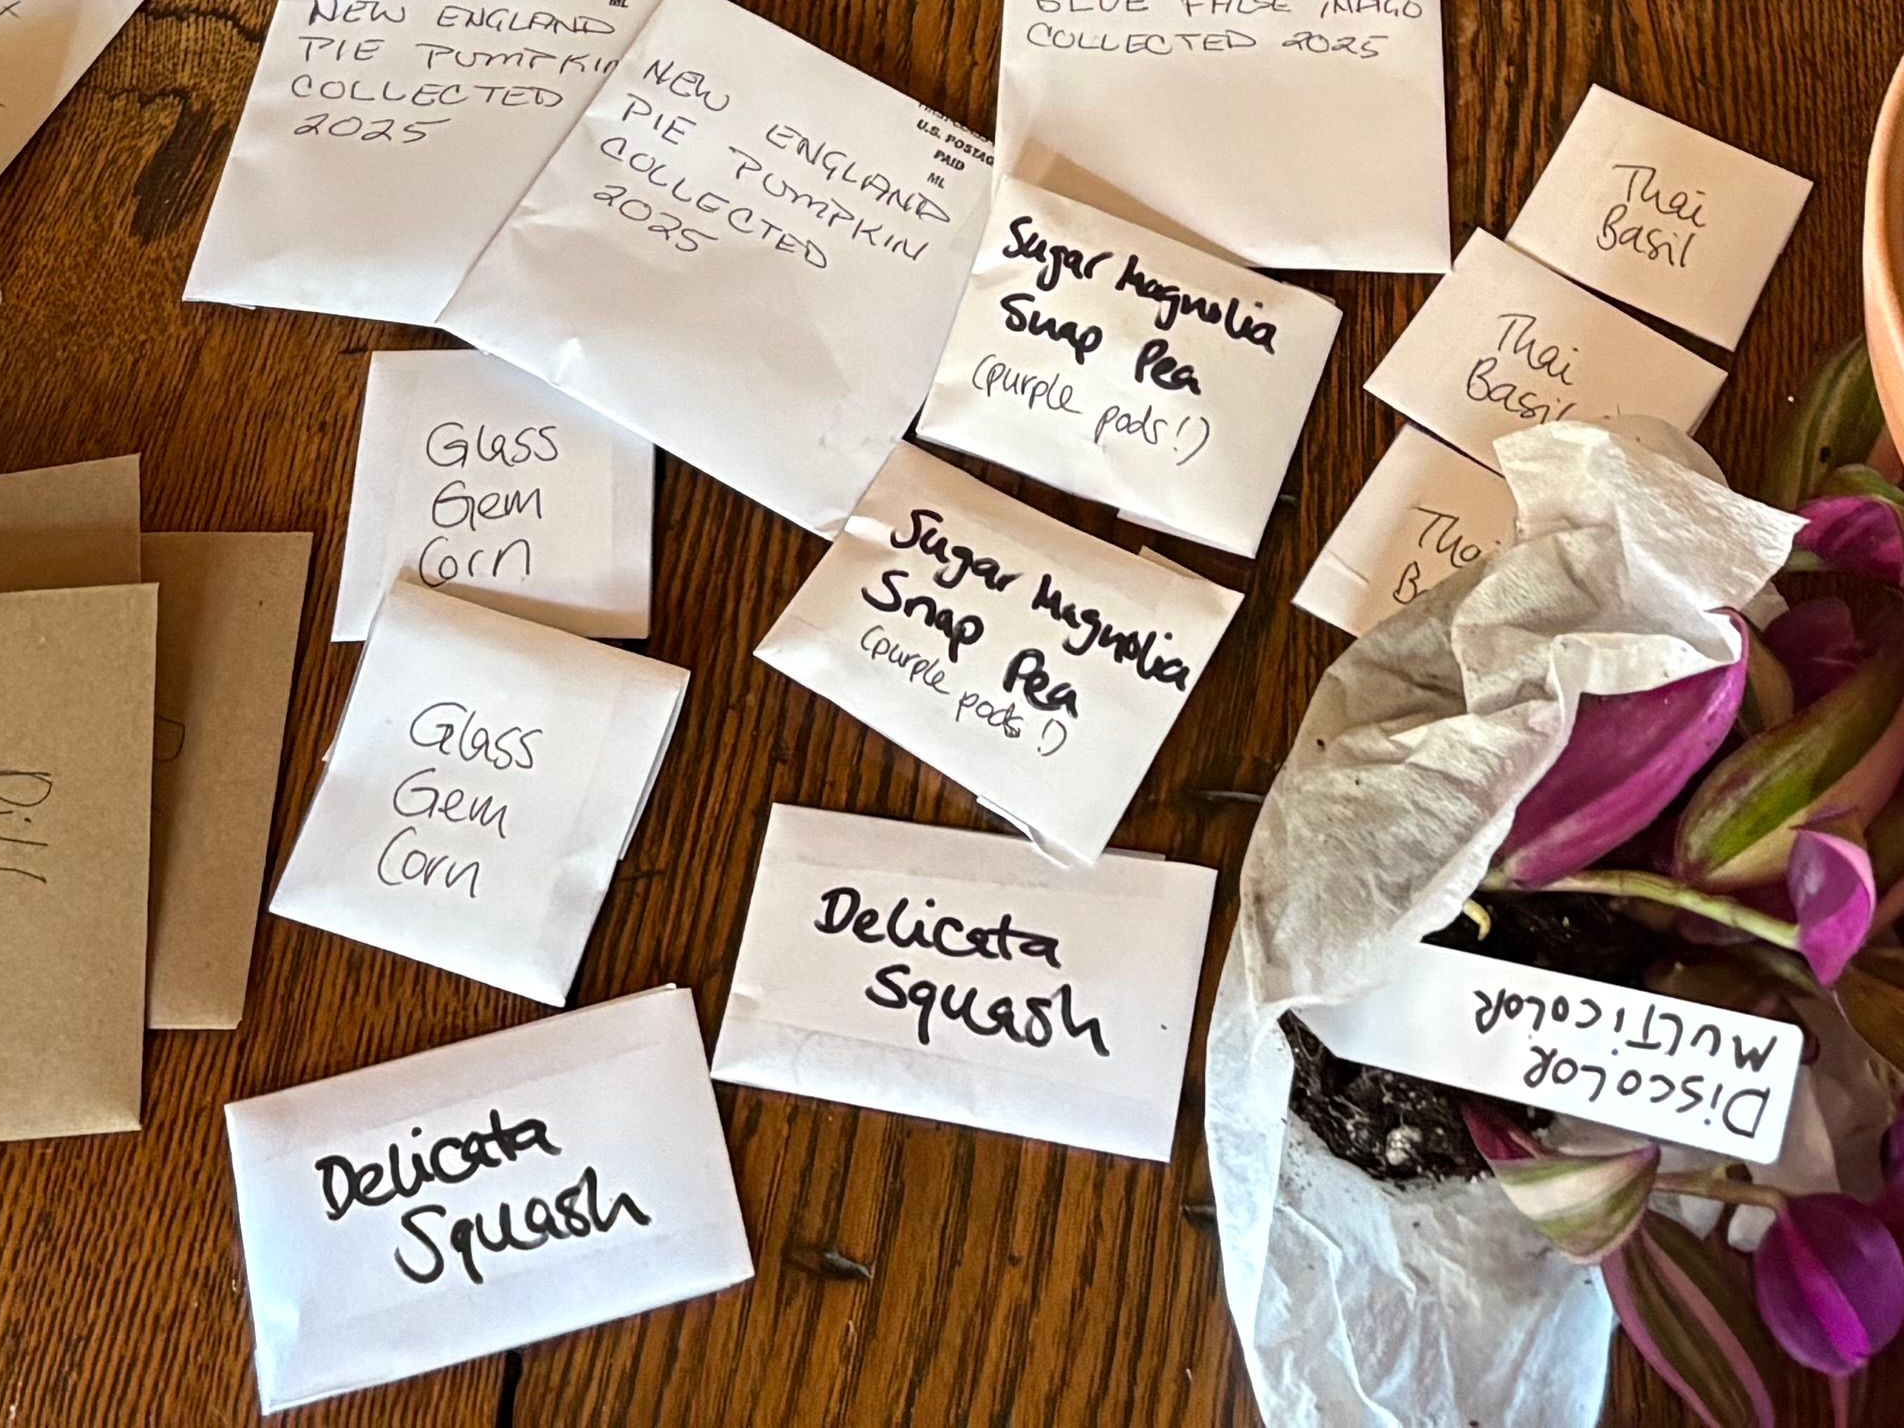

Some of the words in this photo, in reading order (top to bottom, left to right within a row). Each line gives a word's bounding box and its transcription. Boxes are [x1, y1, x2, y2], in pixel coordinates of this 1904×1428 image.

[298, 35, 385, 64] PIE
[436, 4, 618, 36] ENGLAND
[1027, 24, 1259, 56] COLLECTED
[1281, 30, 1390, 60] 2025
[291, 74, 566, 109] COLLECTED
[915, 117, 944, 138] U.S.
[292, 112, 454, 145] 2025
[642, 58, 732, 114] NEW
[766, 121, 952, 225] ENGLAND
[933, 147, 966, 172] PAID
[599, 136, 830, 272] COLLECTED
[621, 93, 698, 146] PIE
[726, 147, 932, 264] PUMPKIN
[926, 171, 946, 189] ML
[1610, 163, 1708, 230] Thai
[593, 182, 719, 254] 2025
[1595, 206, 1694, 269] Basil
[1001, 214, 1113, 293] Sugar
[1114, 256, 1280, 356] Magnolia
[998, 292, 1102, 365] Snap
[1134, 341, 1203, 399] Pea
[1498, 313, 1579, 388] Thai
[424, 421, 560, 465] Glass
[970, 353, 1084, 420] (purple
[1094, 399, 1214, 469] pods!)
[431, 481, 544, 529] Gem
[417, 534, 533, 588] Corn
[889, 506, 1025, 595] Sugar
[1034, 571, 1191, 696] Magnolia
[859, 623, 952, 701] (purple
[861, 568, 986, 652] Snap
[1003, 650, 1082, 720] Pea
[408, 700, 545, 772] Glass
[391, 766, 511, 838] Gem
[376, 827, 482, 901] Corn
[811, 885, 1063, 970] Delicata
[863, 963, 1112, 1059] Squash
[317, 1107, 562, 1225] Delicata
[393, 1165, 652, 1285] Squash
